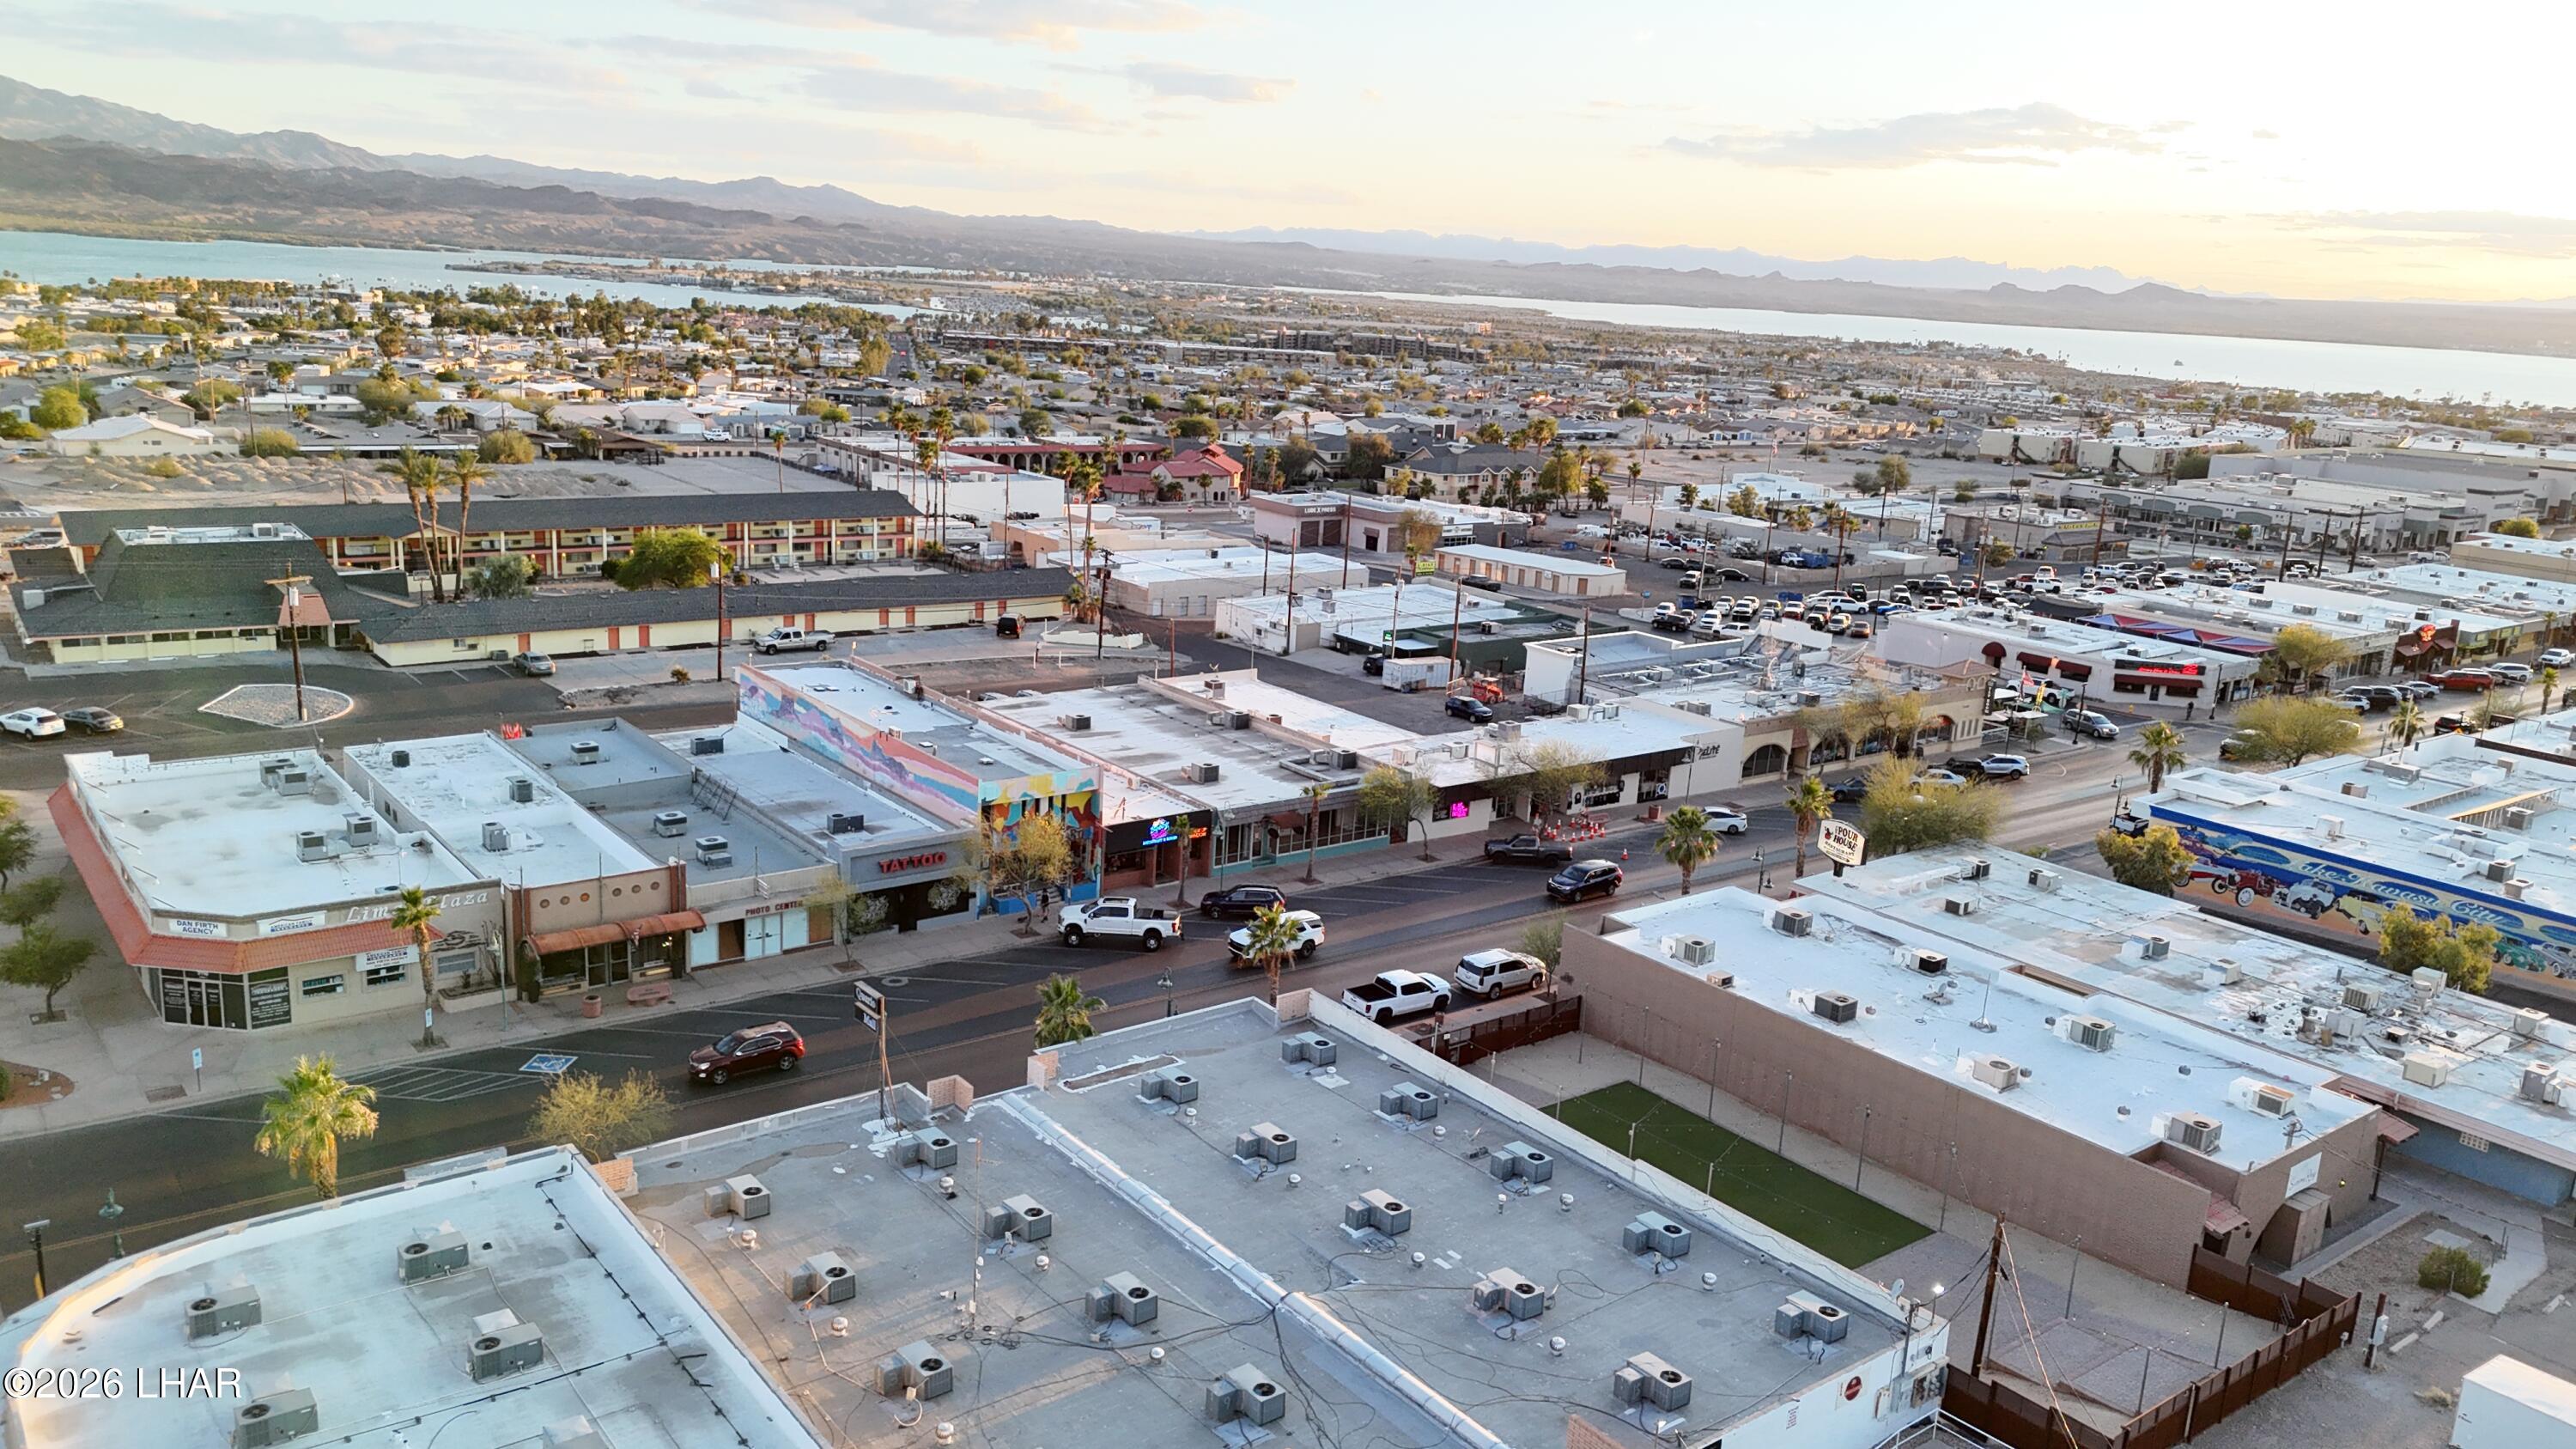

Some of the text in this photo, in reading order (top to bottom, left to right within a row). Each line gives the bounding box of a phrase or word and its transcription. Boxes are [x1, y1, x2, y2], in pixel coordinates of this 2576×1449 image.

[1833, 835, 1857, 851] HOUSE
[1838, 827, 1858, 843] POUR
[878, 851, 947, 874] TATTOO
[347, 904, 402, 922] Lim
[745, 905, 770, 916] PHOTO
[2450, 899, 2505, 925] City
[182, 927, 215, 935] AGENCY
